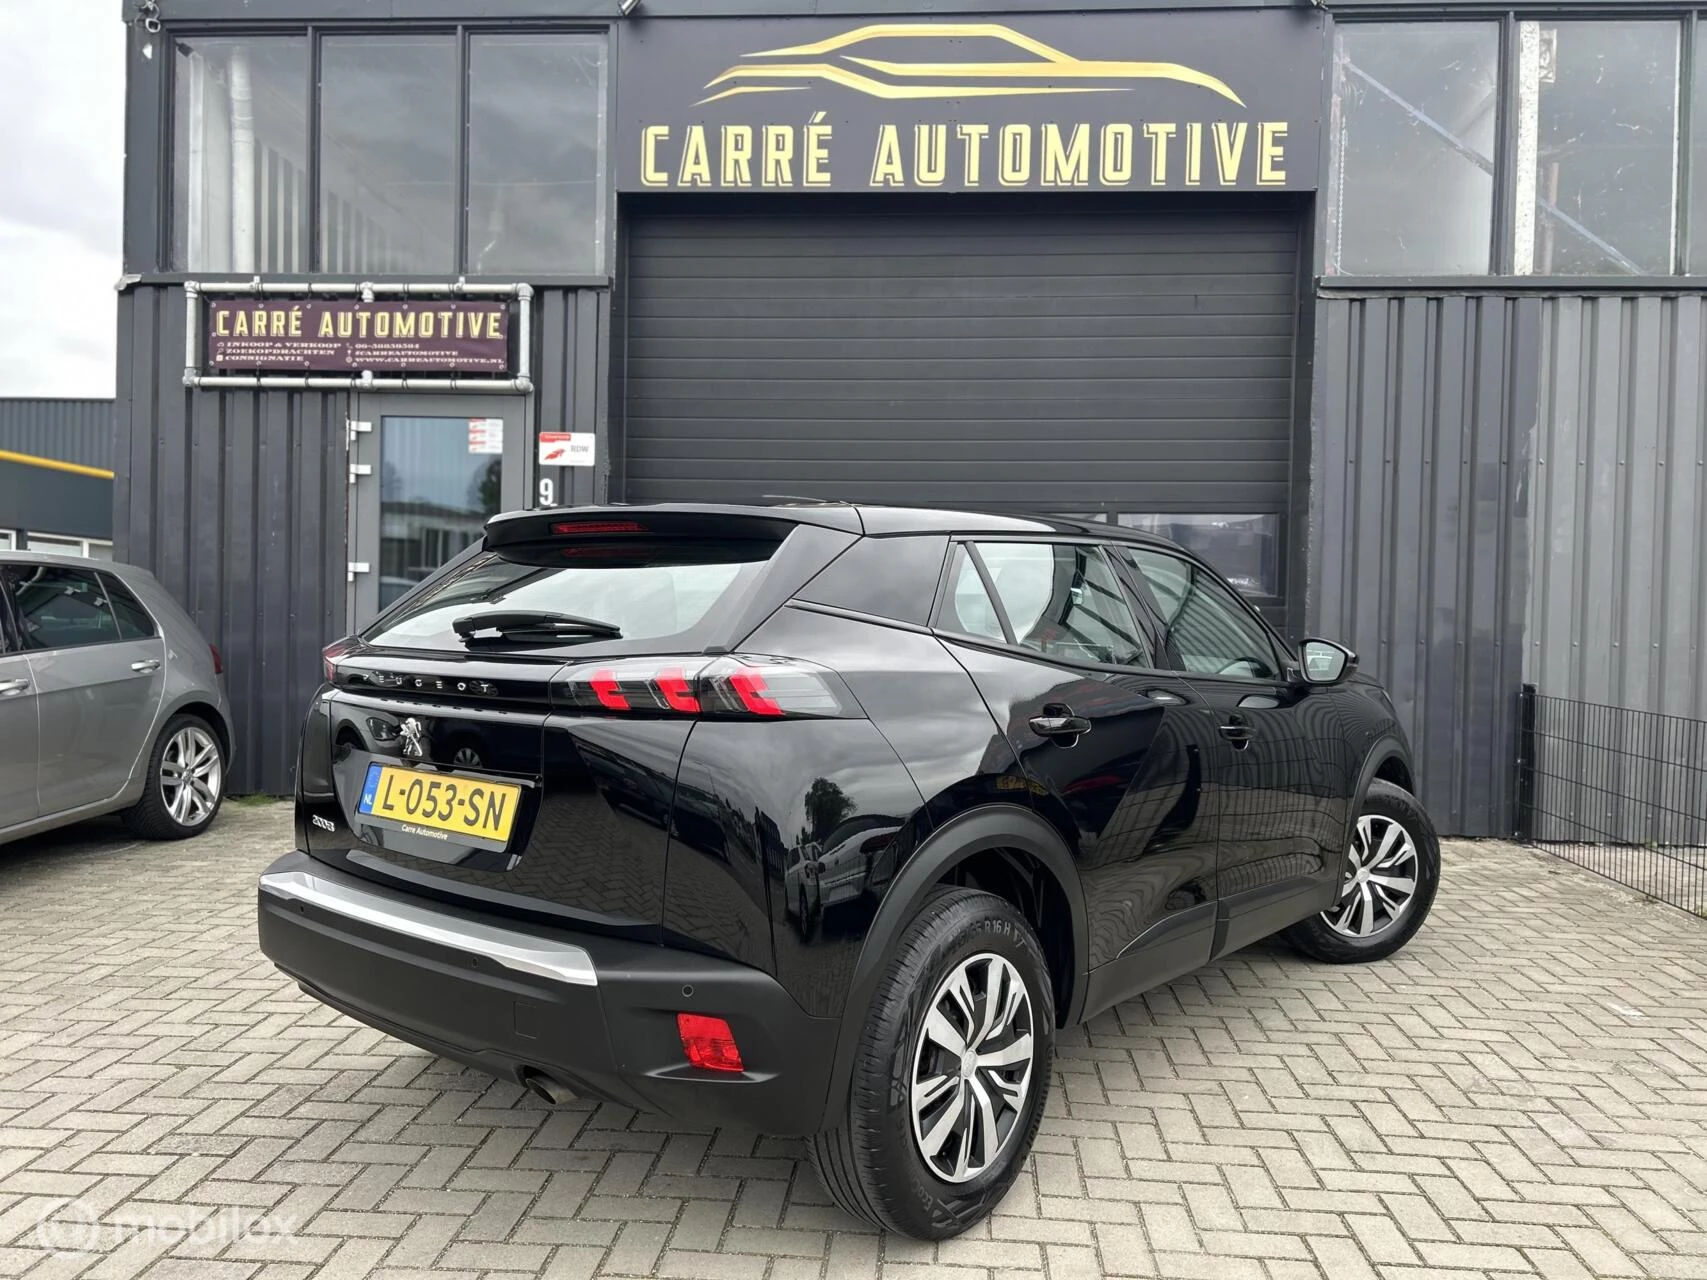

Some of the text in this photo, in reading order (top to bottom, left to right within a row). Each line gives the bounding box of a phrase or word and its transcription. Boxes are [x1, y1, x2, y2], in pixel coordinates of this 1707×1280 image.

[640, 110, 1289, 187] CARRÉ AUTOMOTIVE
[215, 306, 502, 338] CARRÉ AUTOMOTIVE
[540, 478, 554, 506] 9
[362, 672, 490, 692] PEUGEOT
[364, 794, 374, 805] NL
[382, 774, 507, 831] L-053-SN
[401, 824, 448, 840] Carre Automotive
